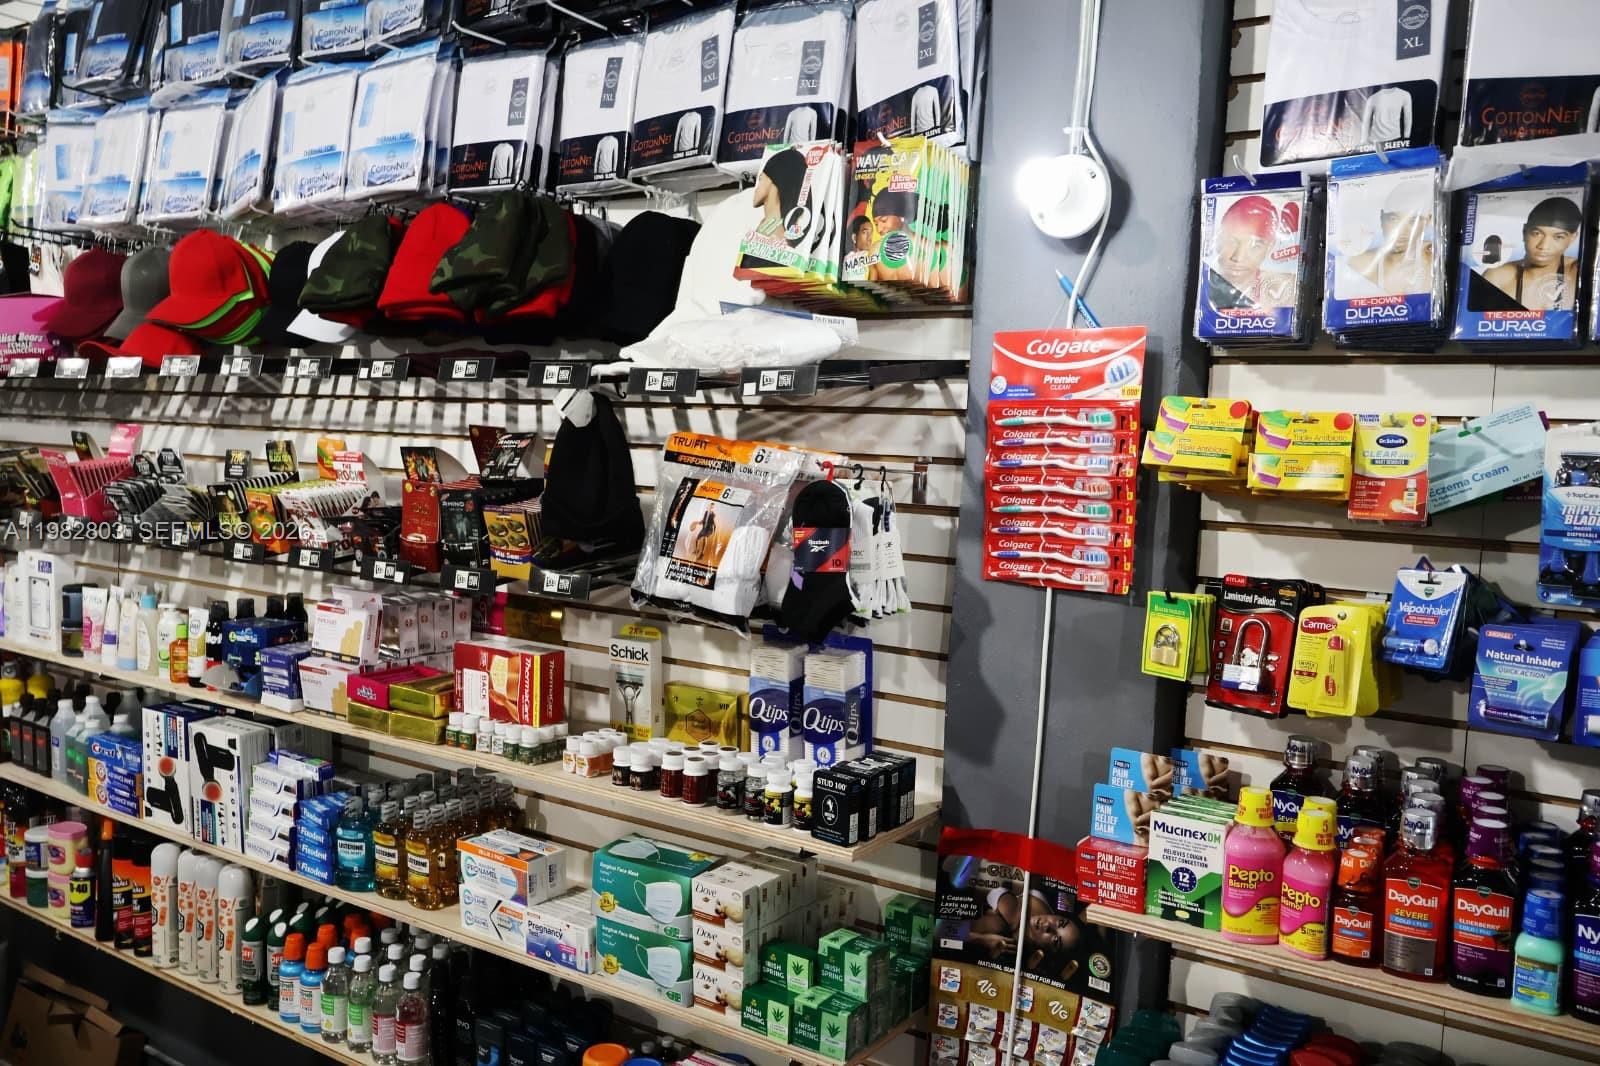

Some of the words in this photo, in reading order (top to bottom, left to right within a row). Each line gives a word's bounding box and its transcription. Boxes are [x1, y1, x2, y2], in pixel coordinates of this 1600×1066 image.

[1402, 36, 1423, 49] XL
[920, 47, 934, 59] 2XL
[1384, 140, 1410, 150] SLEEVE
[856, 153, 887, 169] WAVE
[1273, 249, 1296, 259] Extra
[1352, 296, 1402, 305] TIE-DOWN
[1345, 305, 1408, 320] DURAG
[1487, 311, 1541, 319] TIE-DOWN
[1215, 317, 1276, 330] DURAG
[1478, 320, 1546, 332] DURAG
[1026, 338, 1102, 359] Colgate
[1043, 374, 1081, 384] Premier
[1002, 408, 1038, 417] Colgate
[1003, 430, 1039, 439] Colgate
[1293, 434, 1311, 442] Triple
[1363, 450, 1397, 458] CLEAR
[739, 466, 753, 475] LOW
[999, 474, 1035, 483] Colgate
[1429, 479, 1470, 498] Eczema
[1471, 464, 1510, 483] Cream
[722, 488, 731, 499] 6
[1001, 495, 1036, 505] Colgate
[1000, 518, 1036, 527] Colgate
[998, 540, 1033, 550] Colgate
[832, 559, 842, 567] 10
[998, 562, 1034, 572] Colgate
[1224, 590, 1252, 604] Laminated
[1253, 594, 1276, 607] Padlock
[1302, 619, 1336, 631] Carmex
[610, 644, 649, 662] Schick
[1486, 649, 1524, 664] Natural
[1526, 654, 1563, 669] Inhaler
[1498, 667, 1519, 675] QUICK
[1520, 670, 1546, 680] ACTION
[91, 743, 115, 758] Crest
[1112, 767, 1128, 778] PAIN
[817, 777, 834, 788] STUD
[834, 781, 846, 791] 100
[1112, 776, 1135, 789] RELIEF
[1265, 794, 1271, 805] 5
[1096, 803, 1112, 814] PAIN
[1095, 812, 1118, 826] RELIEF
[1403, 818, 1431, 830] DayQuil
[301, 826, 324, 843] Fixodent
[1094, 823, 1114, 835] BALM
[1208, 834, 1221, 844] DM
[302, 844, 327, 861] Fixodent
[338, 842, 364, 851] LISTERINE
[1097, 852, 1114, 863] PAIN
[1114, 855, 1137, 867] RELIEF
[1163, 848, 1185, 857] RELIEVES
[1186, 852, 1203, 861] COUGH
[1097, 861, 1116, 872] BALM
[1162, 854, 1176, 863] CHEST
[1177, 857, 1208, 868] CONGESTION
[301, 863, 328, 879] Fixodent
[1178, 872, 1190, 882] 12
[1229, 864, 1274, 886] Pepto
[695, 882, 716, 897] Dove
[1098, 880, 1114, 891] PAIN
[1115, 883, 1138, 896] RELIEF
[1228, 879, 1257, 890] Bismol
[1098, 890, 1117, 901] BALM
[1281, 882, 1320, 908] Pepto
[1388, 889, 1438, 909] DayQuil
[1280, 896, 1303, 912] Bismol
[1457, 898, 1510, 918] DayQuil
[1395, 908, 1428, 920] SEVERE
[1334, 914, 1371, 930] DayQuil
[1395, 917, 1411, 925] COLD
[1459, 918, 1500, 930] ELDERBERRY
[527, 920, 563, 939] Pregnancy
[696, 926, 718, 941] Dove
[765, 961, 782, 970] IRISH
[823, 963, 840, 973] IRISH
[695, 970, 718, 984] Dove
[762, 966, 784, 979] SPRING
[821, 969, 843, 982] SPRING
[978, 960, 1003, 971] NATURAL
[1051, 978, 1066, 989] MEN!
[745, 1006, 762, 1017] IRISH
[743, 1012, 765, 1025] SPRING
[798, 1022, 816, 1033] IRISH
[794, 1028, 819, 1041] SPRING
